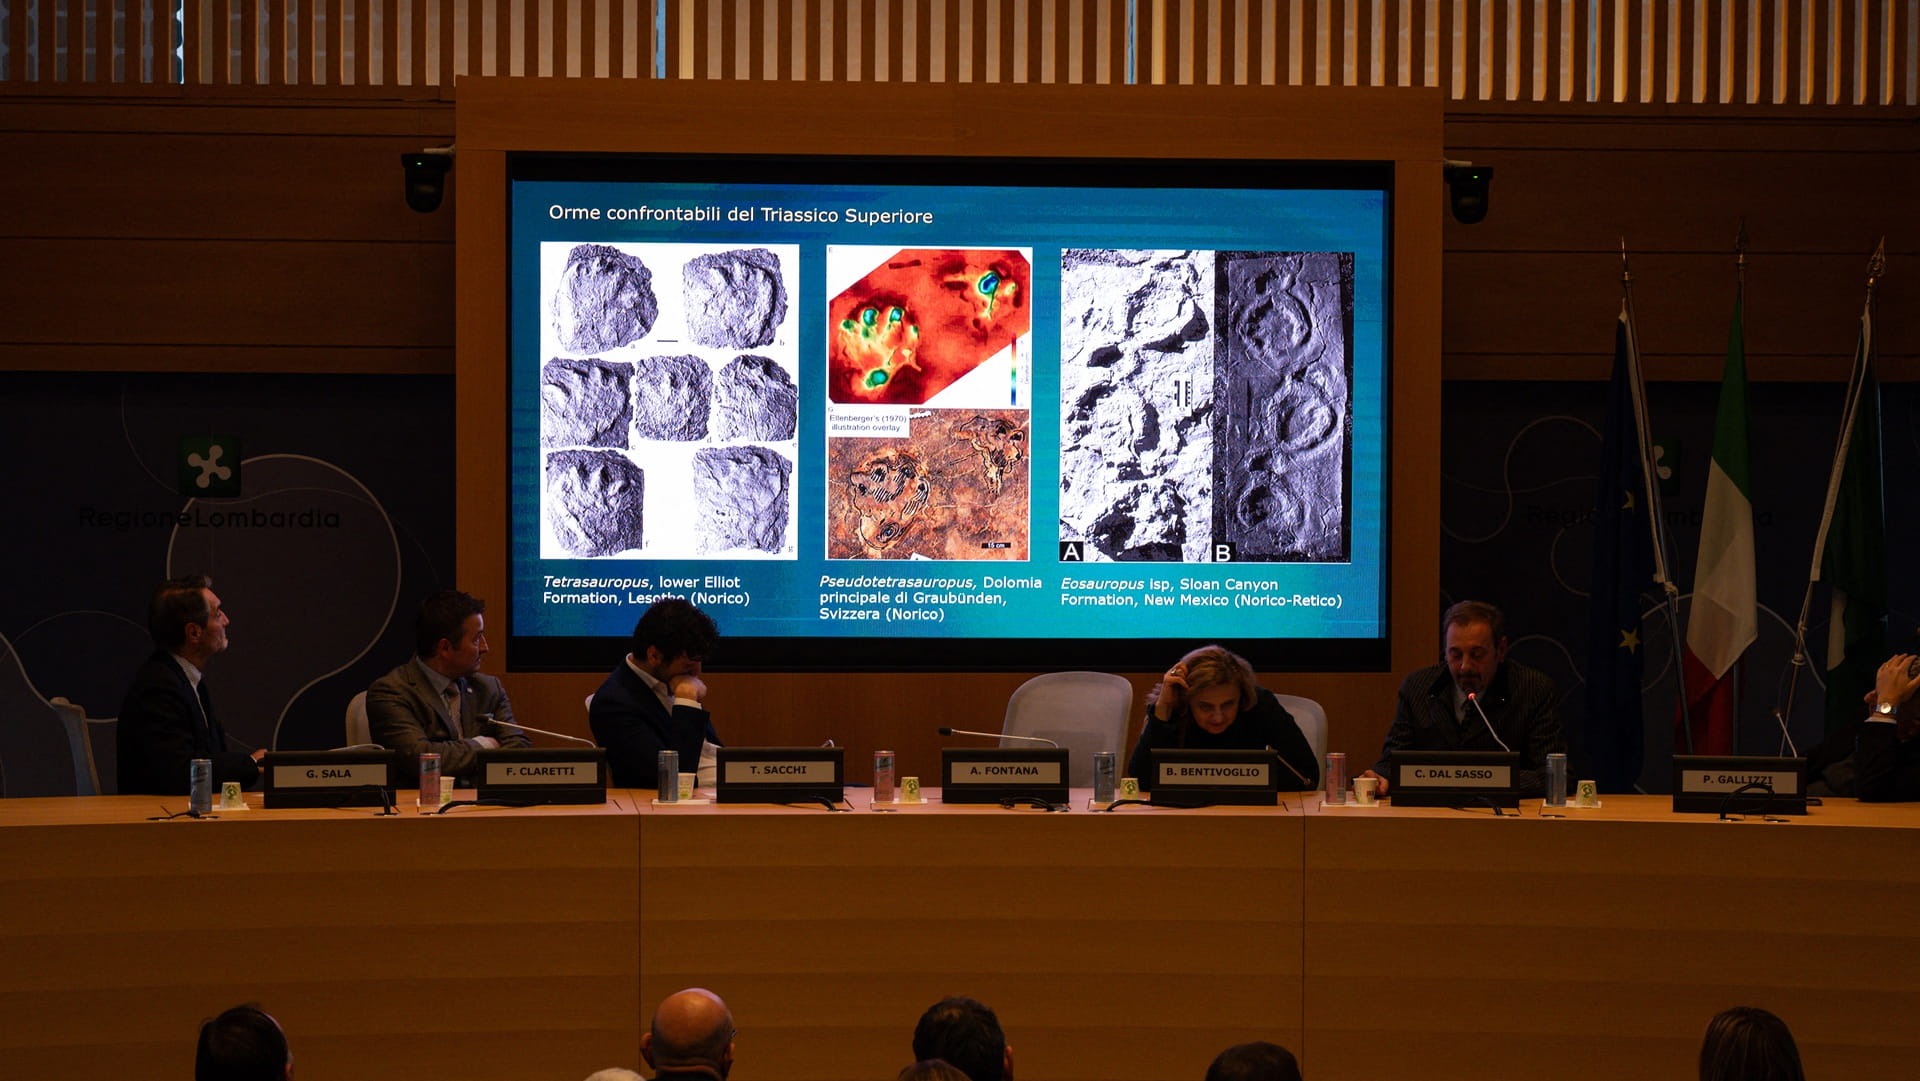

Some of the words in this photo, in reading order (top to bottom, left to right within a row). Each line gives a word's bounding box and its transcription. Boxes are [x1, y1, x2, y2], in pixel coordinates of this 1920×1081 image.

[549, 204, 601, 220] Orme
[606, 205, 721, 222] confrontabili
[727, 206, 755, 222] del
[761, 207, 839, 223] Triassico
[845, 208, 934, 226] Superiore
[829, 414, 880, 424] Ellenberger's
[881, 414, 907, 424] (1970)
[831, 423, 871, 431] illustration
[872, 424, 901, 433] overlay
[1063, 543, 1081, 561] A
[1215, 544, 1232, 561] B
[543, 575, 654, 590] Tetrasauropus,
[659, 575, 700, 588] lower
[704, 576, 741, 589] Elliot
[819, 575, 977, 591] Pseudotetrasauropus,
[982, 576, 1043, 589] Dolomia
[1060, 577, 1145, 592] Eosauropus
[1149, 578, 1175, 593] isp,
[1179, 578, 1220, 591] Sloan
[1225, 578, 1279, 594] Canyon
[543, 592, 622, 606] Formation,
[690, 592, 750, 607] (Norico)
[819, 591, 890, 606] principale
[894, 592, 908, 604] di
[913, 592, 1007, 607] Graubünden,
[1060, 593, 1140, 608] Formation,
[1144, 594, 1175, 606] New
[1180, 594, 1230, 607] Mexico
[1234, 594, 1343, 609] (Norico-Retico)
[819, 608, 880, 620] Svizzera
[885, 608, 945, 623] (Norico)
[306, 769, 319, 779] G.
[321, 769, 352, 778] SALA
[506, 767, 517, 776] F.
[519, 767, 575, 776] CLARETTI
[749, 765, 761, 775] T.
[763, 765, 807, 775] SACCHI
[970, 766, 982, 775] A.
[985, 766, 1039, 775] FONTANA
[1166, 767, 1177, 776] B.
[1180, 767, 1260, 777] BENTIVOGLIO
[1414, 769, 1426, 778] C.
[1429, 769, 1452, 778] DAL
[1454, 770, 1493, 779] SASSO
[1703, 774, 1715, 784] P.
[1717, 775, 1773, 785] GALLIZZI
